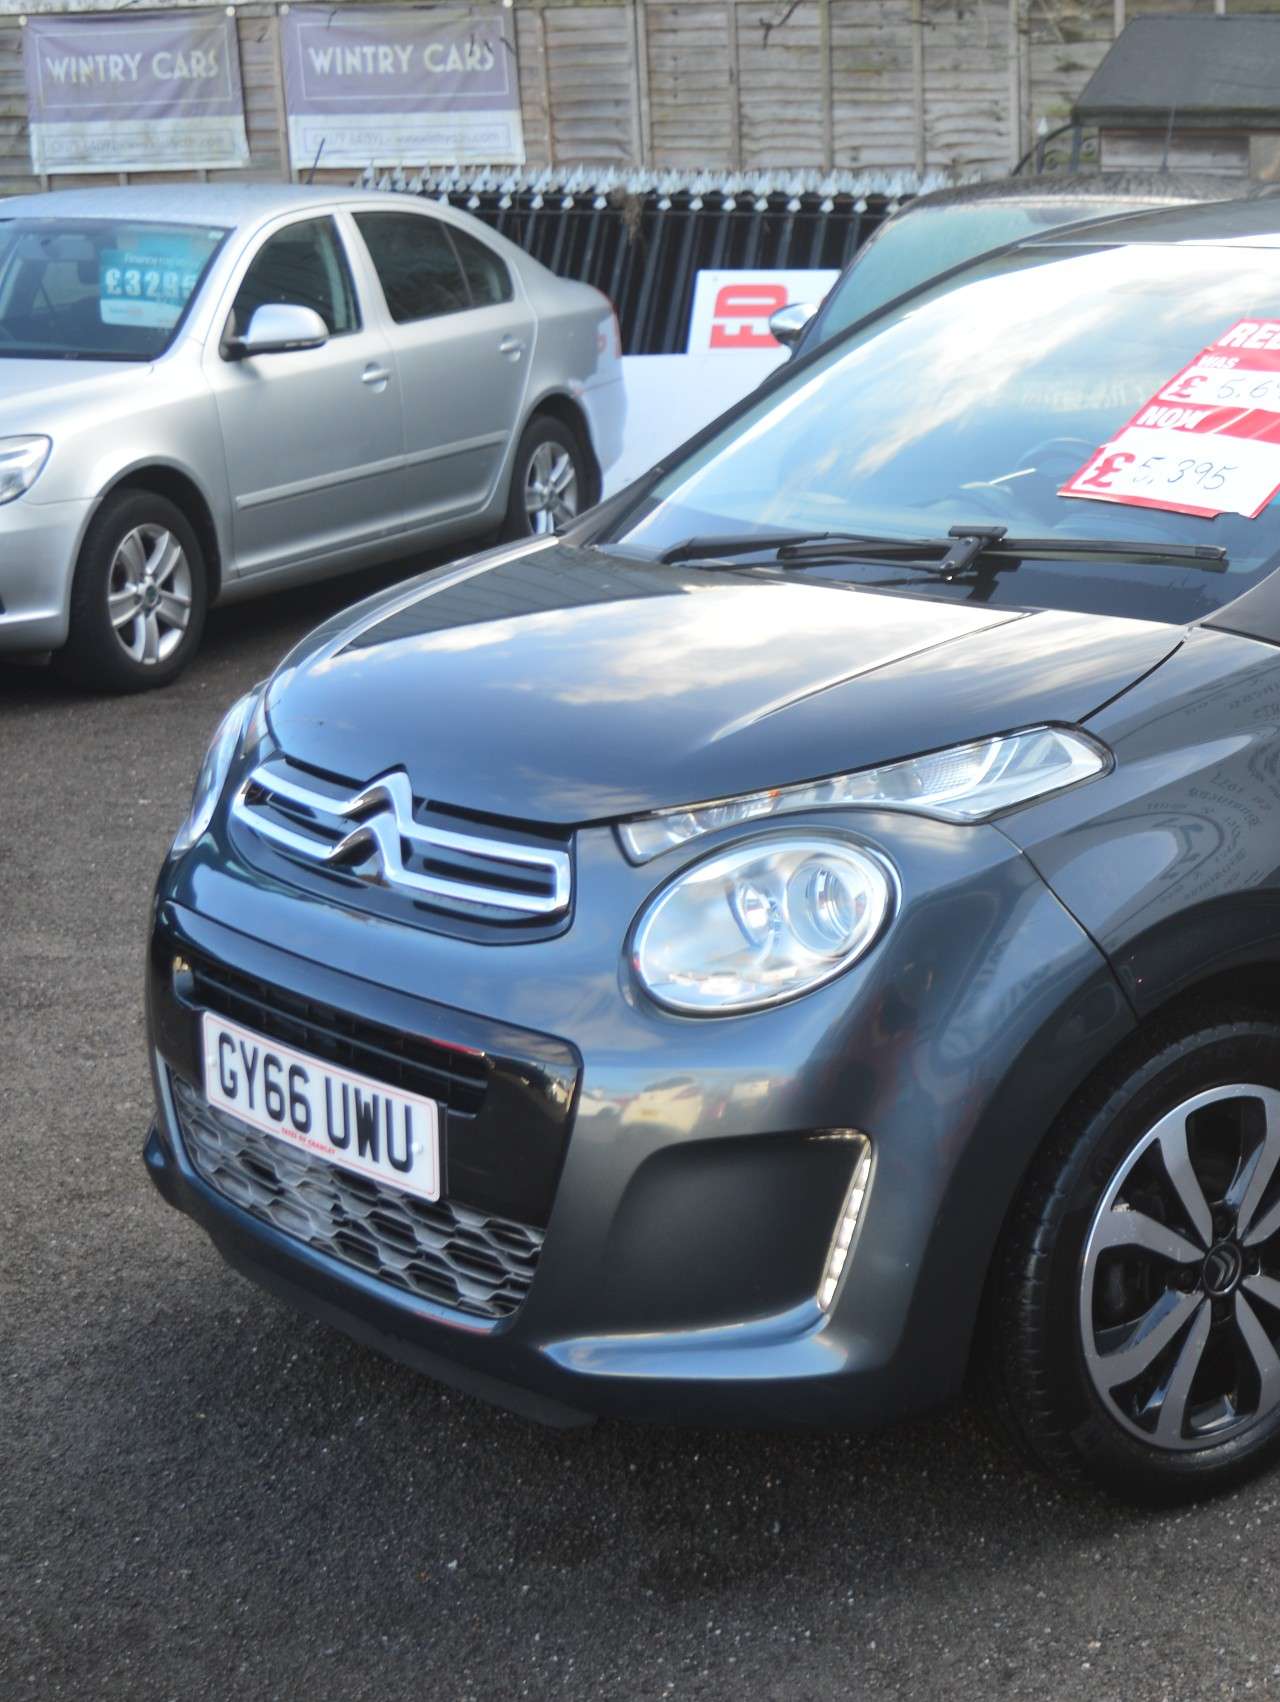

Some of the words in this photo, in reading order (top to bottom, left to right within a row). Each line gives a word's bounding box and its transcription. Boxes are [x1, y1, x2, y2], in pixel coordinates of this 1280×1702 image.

[45, 52, 143, 84] WINTRY
[151, 48, 220, 80] CARS
[307, 44, 413, 75] WINTRY
[423, 40, 496, 73] CARS
[1198, 355, 1240, 370] WAS
[1136, 406, 1211, 430] NOW
[218, 1031, 313, 1135] GY66
[324, 1075, 414, 1174] UWU
